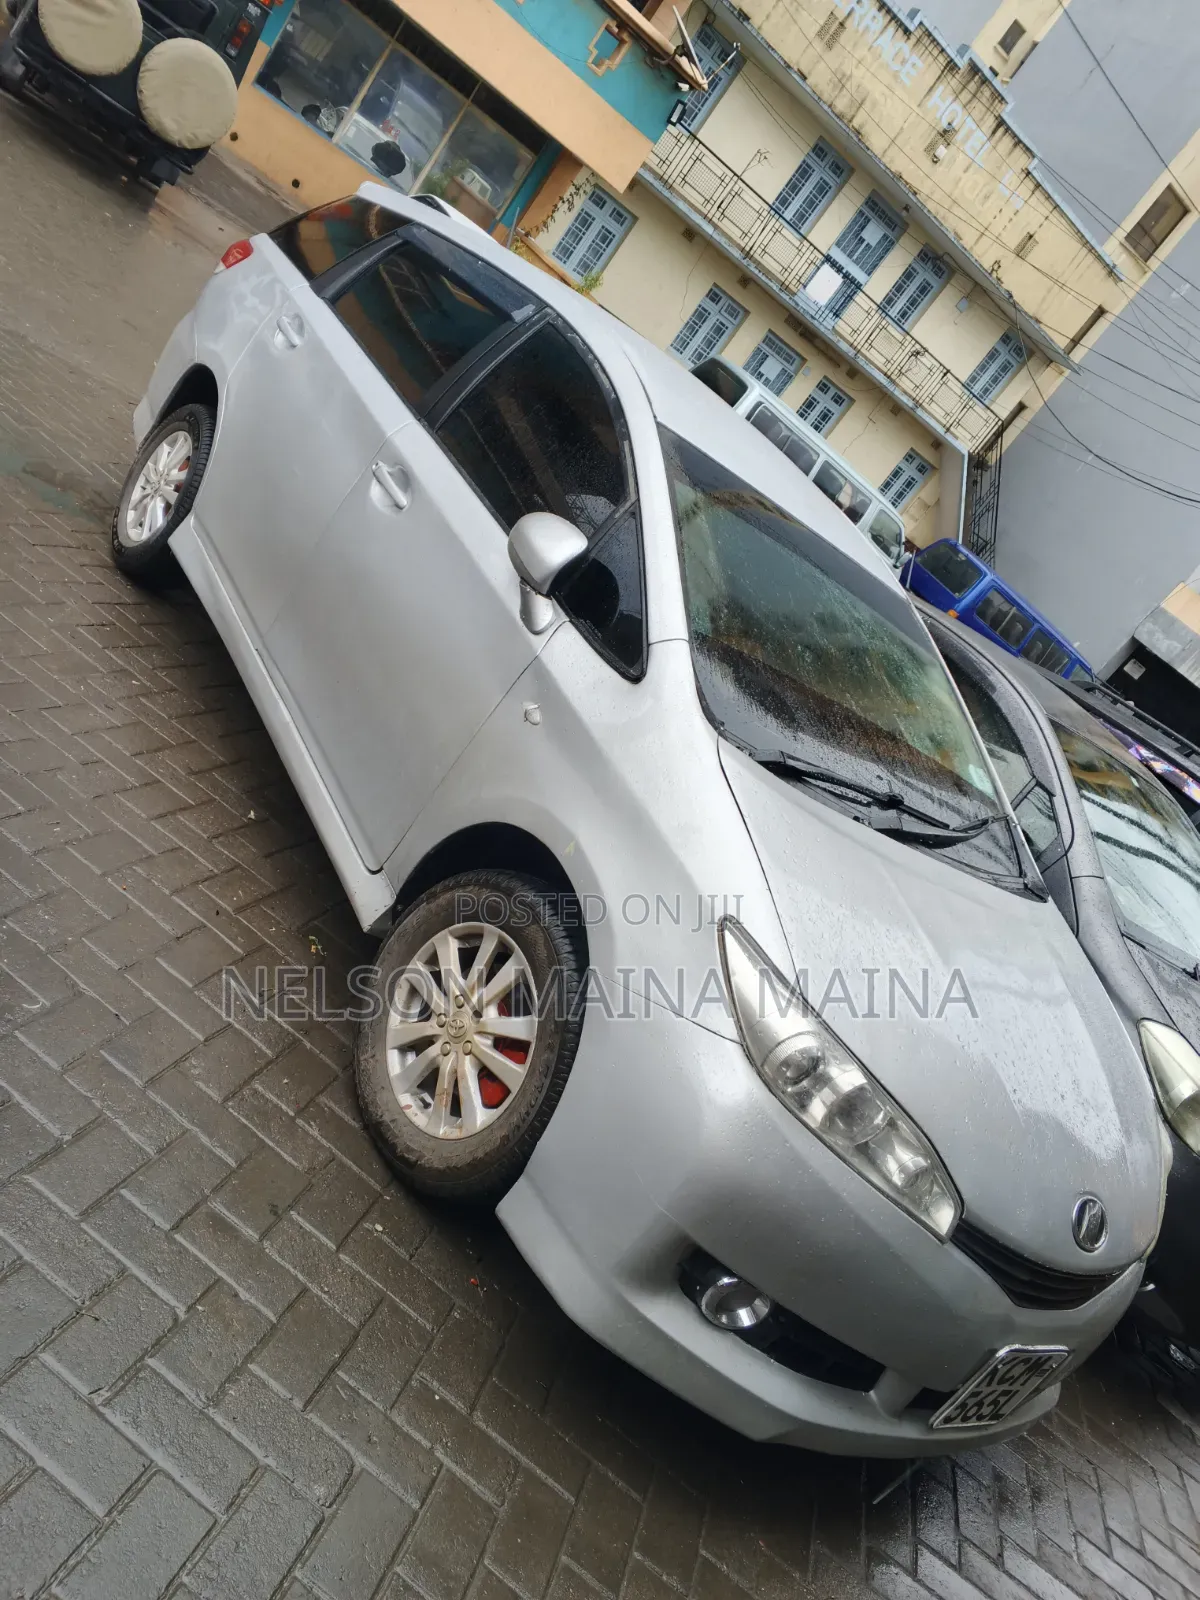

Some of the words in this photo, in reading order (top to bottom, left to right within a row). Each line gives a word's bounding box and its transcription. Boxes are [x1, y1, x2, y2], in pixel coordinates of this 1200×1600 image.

[927, 85, 990, 168] HOTEL
[975, 1355, 1053, 1388] KCM
[942, 1388, 1021, 1424] 565L
